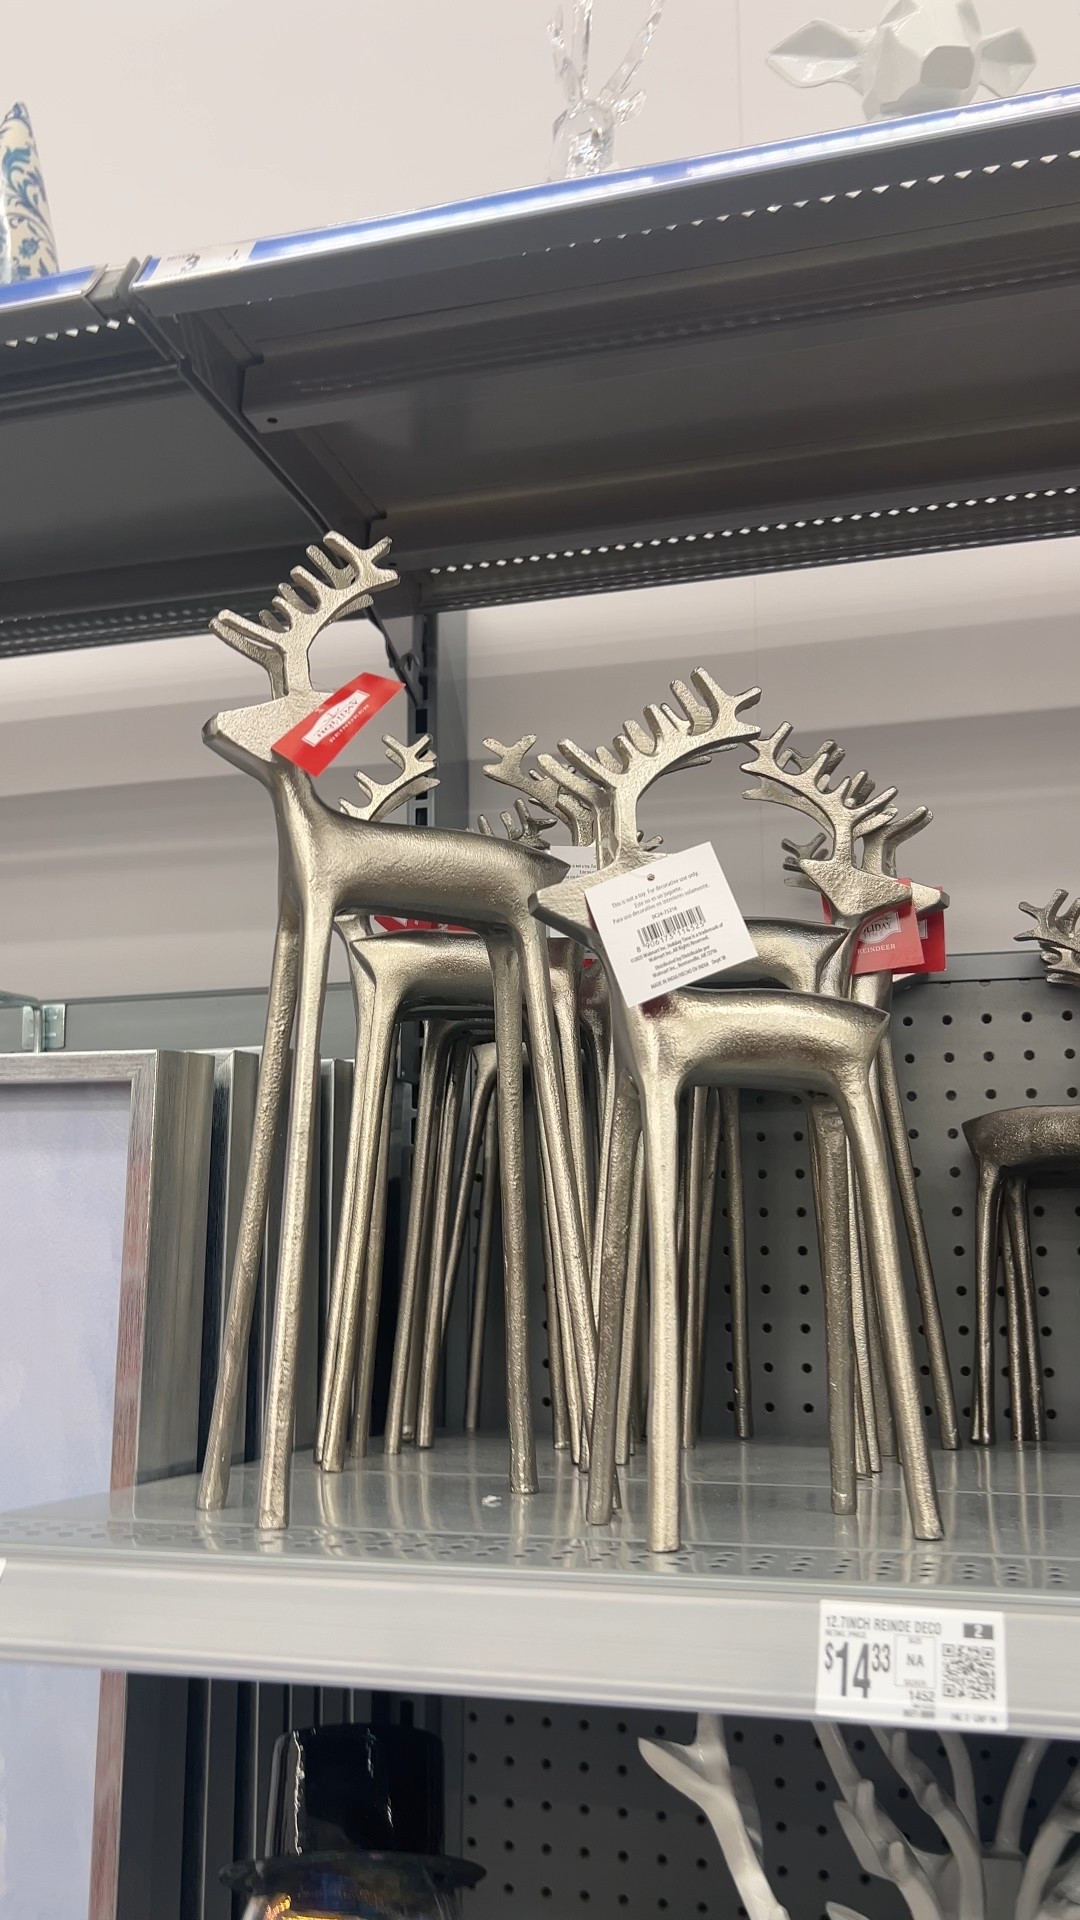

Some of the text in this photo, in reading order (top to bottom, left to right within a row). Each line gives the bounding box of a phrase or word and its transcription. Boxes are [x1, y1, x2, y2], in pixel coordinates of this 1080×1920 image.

[655, 878, 679, 890] decorative
[858, 944, 896, 954] REINDEER
[874, 1617, 911, 1632] REINDE
[915, 1620, 942, 1635] DECO
[906, 1653, 924, 1667] NA
